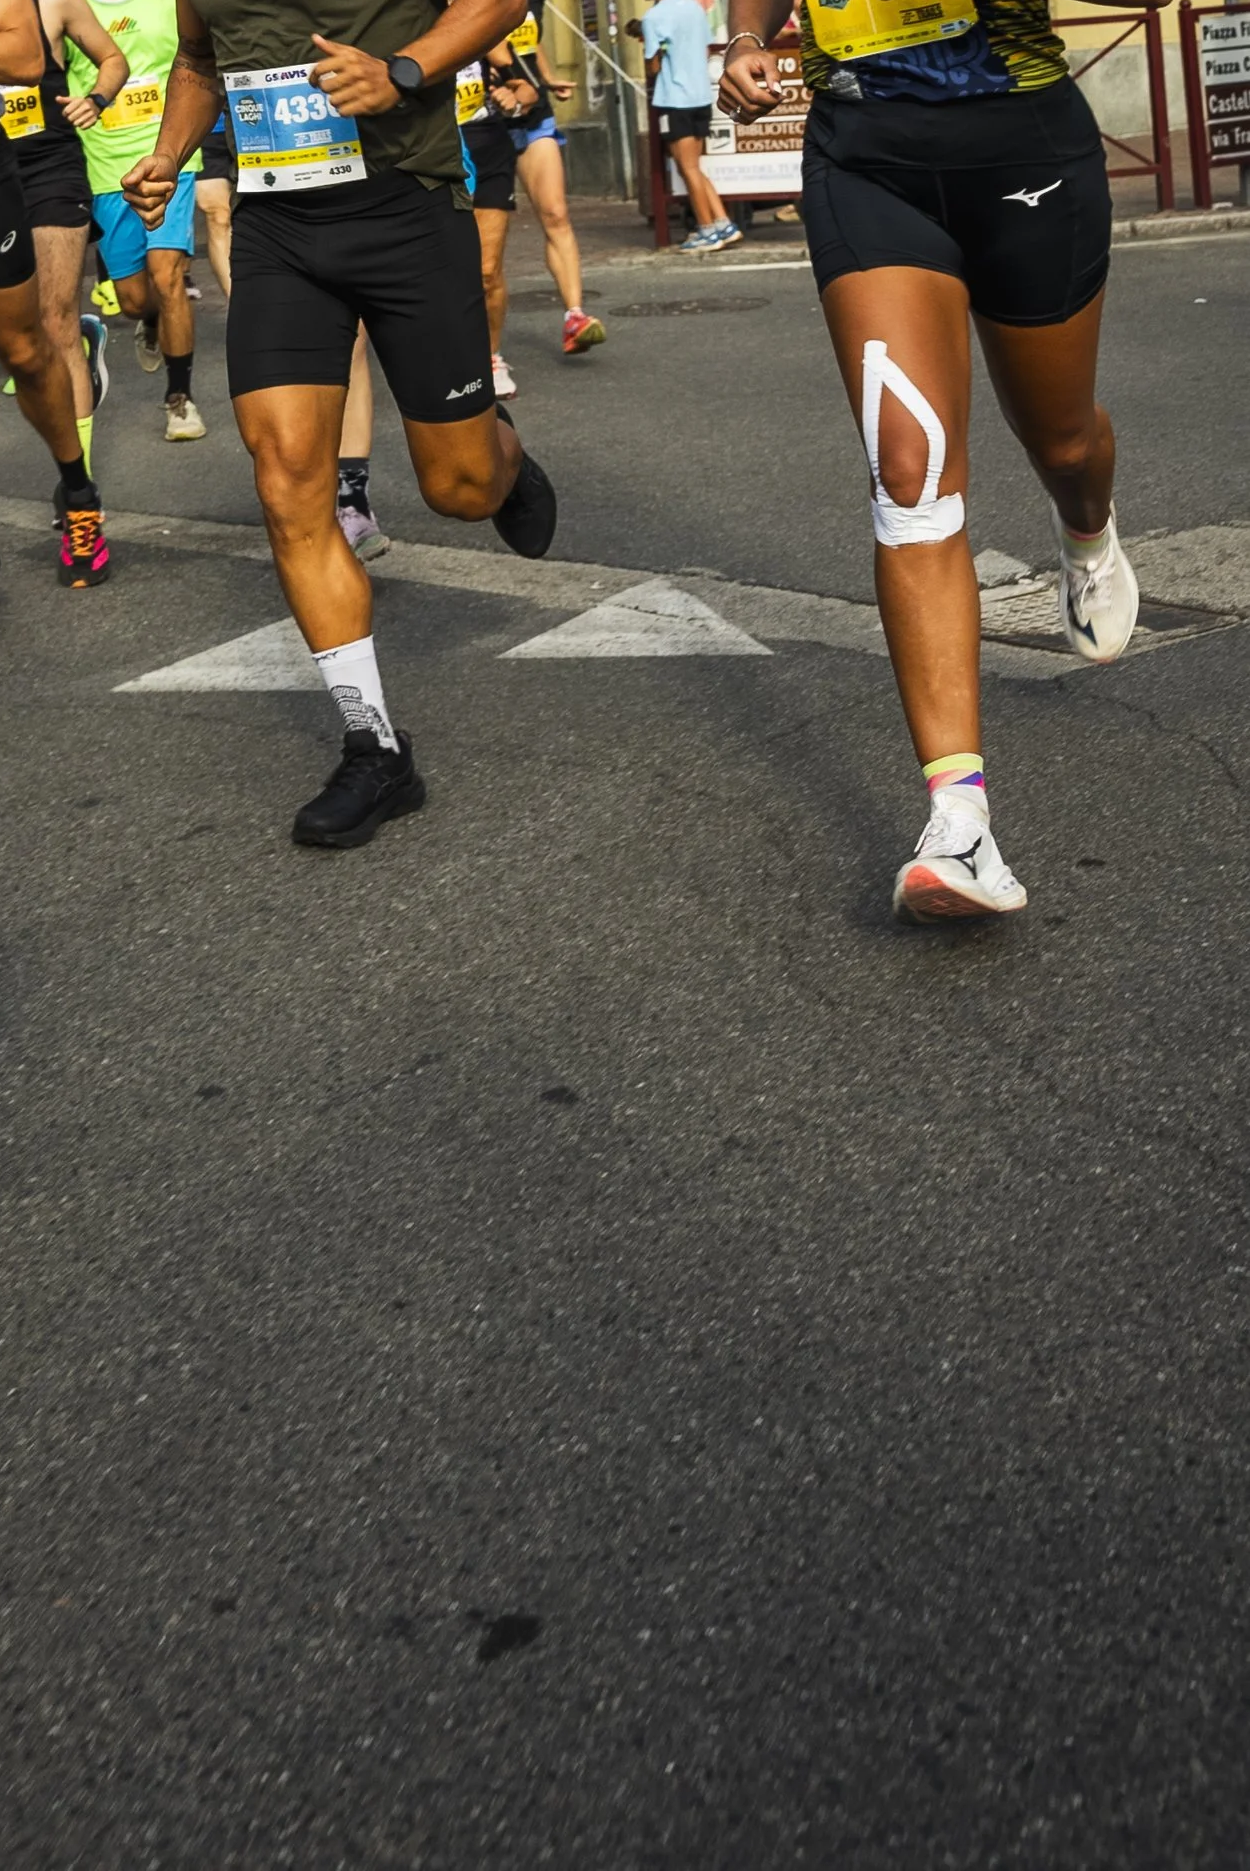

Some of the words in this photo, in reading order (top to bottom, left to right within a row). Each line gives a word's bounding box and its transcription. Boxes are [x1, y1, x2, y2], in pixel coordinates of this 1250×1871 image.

[1202, 23, 1237, 41] Piazza
[1205, 60, 1240, 76] Piazza
[125, 89, 159, 107] 3328
[234, 103, 264, 113] CINQUE
[1212, 130, 1229, 148] via
[329, 164, 352, 176] 4330
